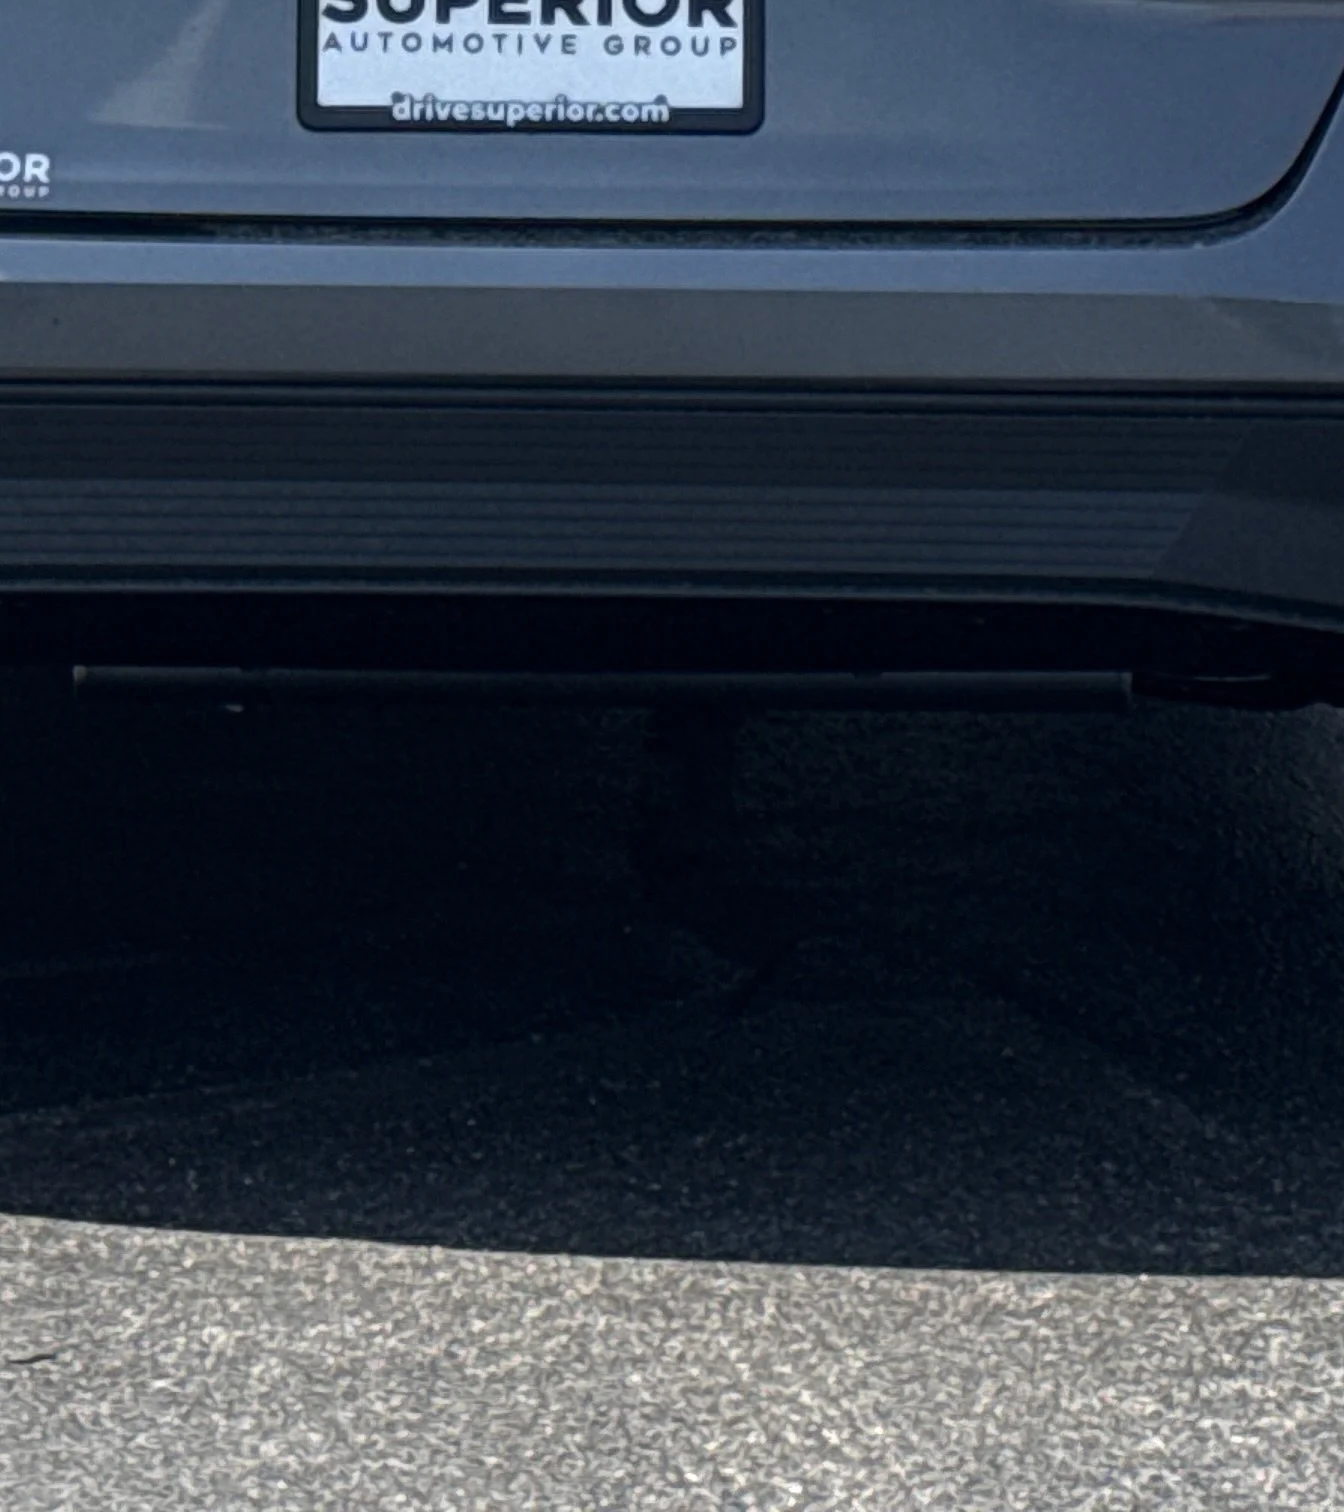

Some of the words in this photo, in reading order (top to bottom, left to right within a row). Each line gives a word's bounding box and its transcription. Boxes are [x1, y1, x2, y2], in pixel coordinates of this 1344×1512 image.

[322, 31, 578, 56] AUTOMOTIVE
[603, 33, 738, 57] GROUP
[392, 94, 669, 127] drivesuperior.com
